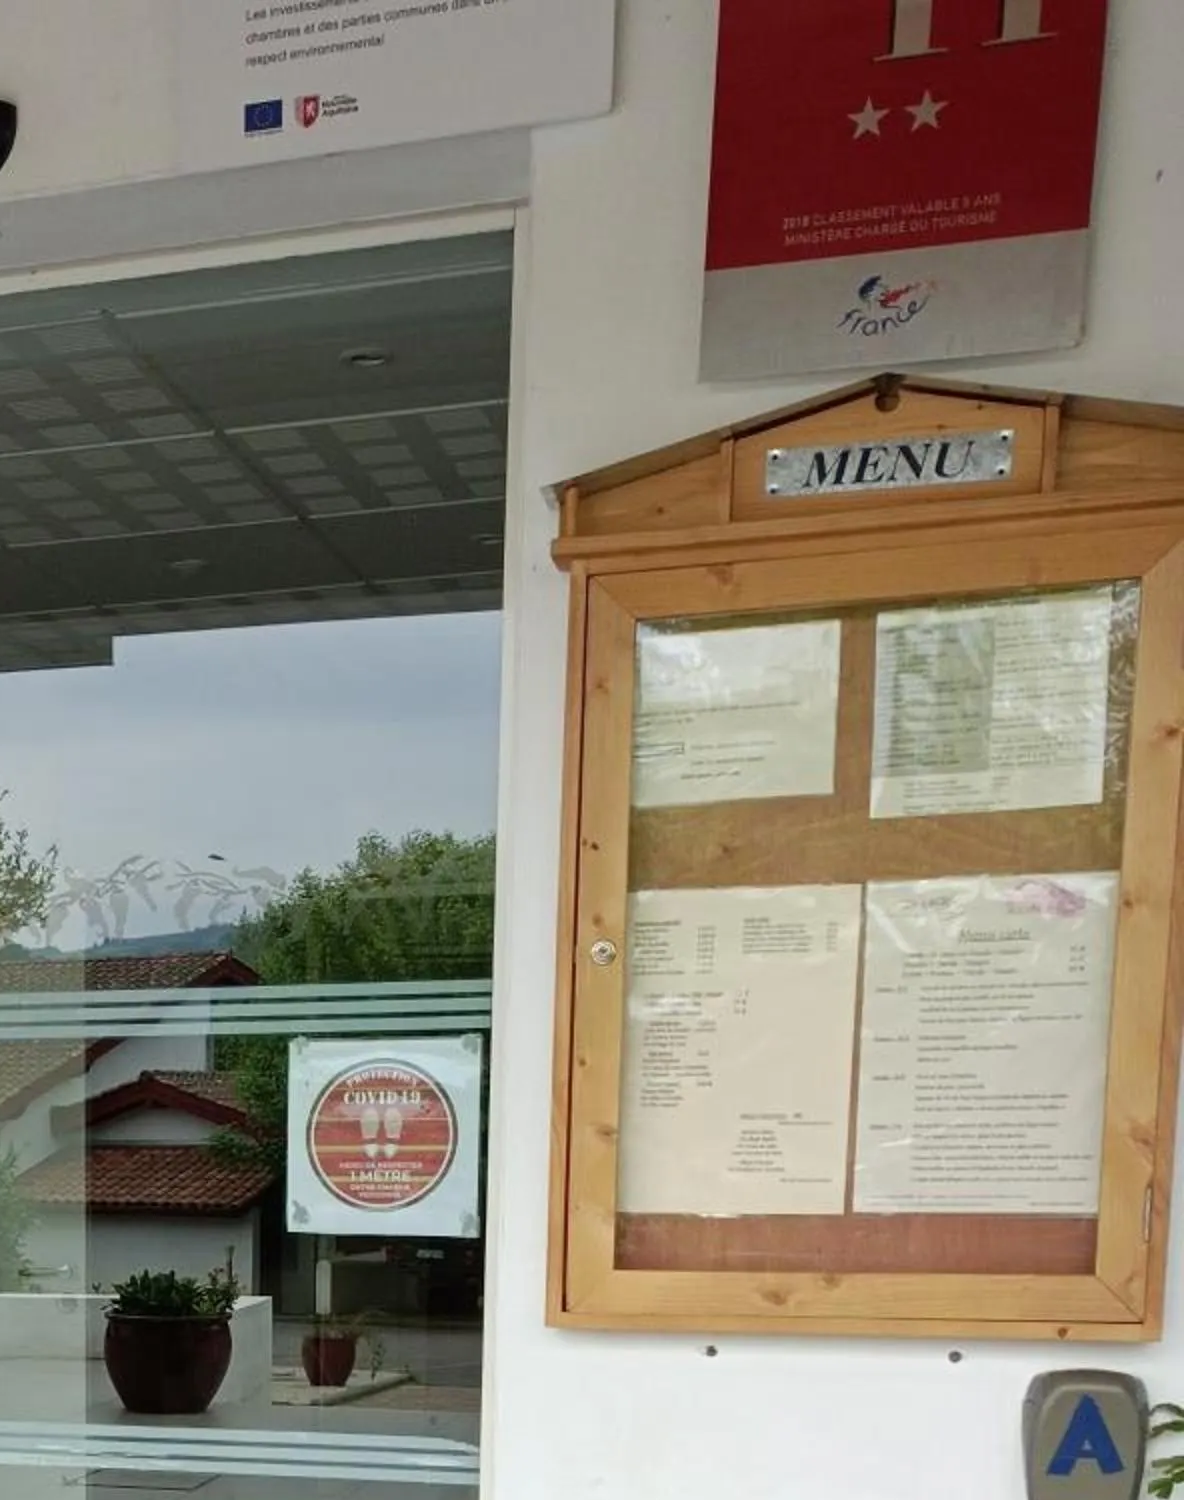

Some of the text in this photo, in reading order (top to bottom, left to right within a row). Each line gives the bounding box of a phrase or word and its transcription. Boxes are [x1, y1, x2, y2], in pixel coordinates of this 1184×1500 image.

[813, 205, 896, 226] CLASSEMENT
[802, 440, 976, 488] MENU
[1046, 1393, 1125, 1476] A
